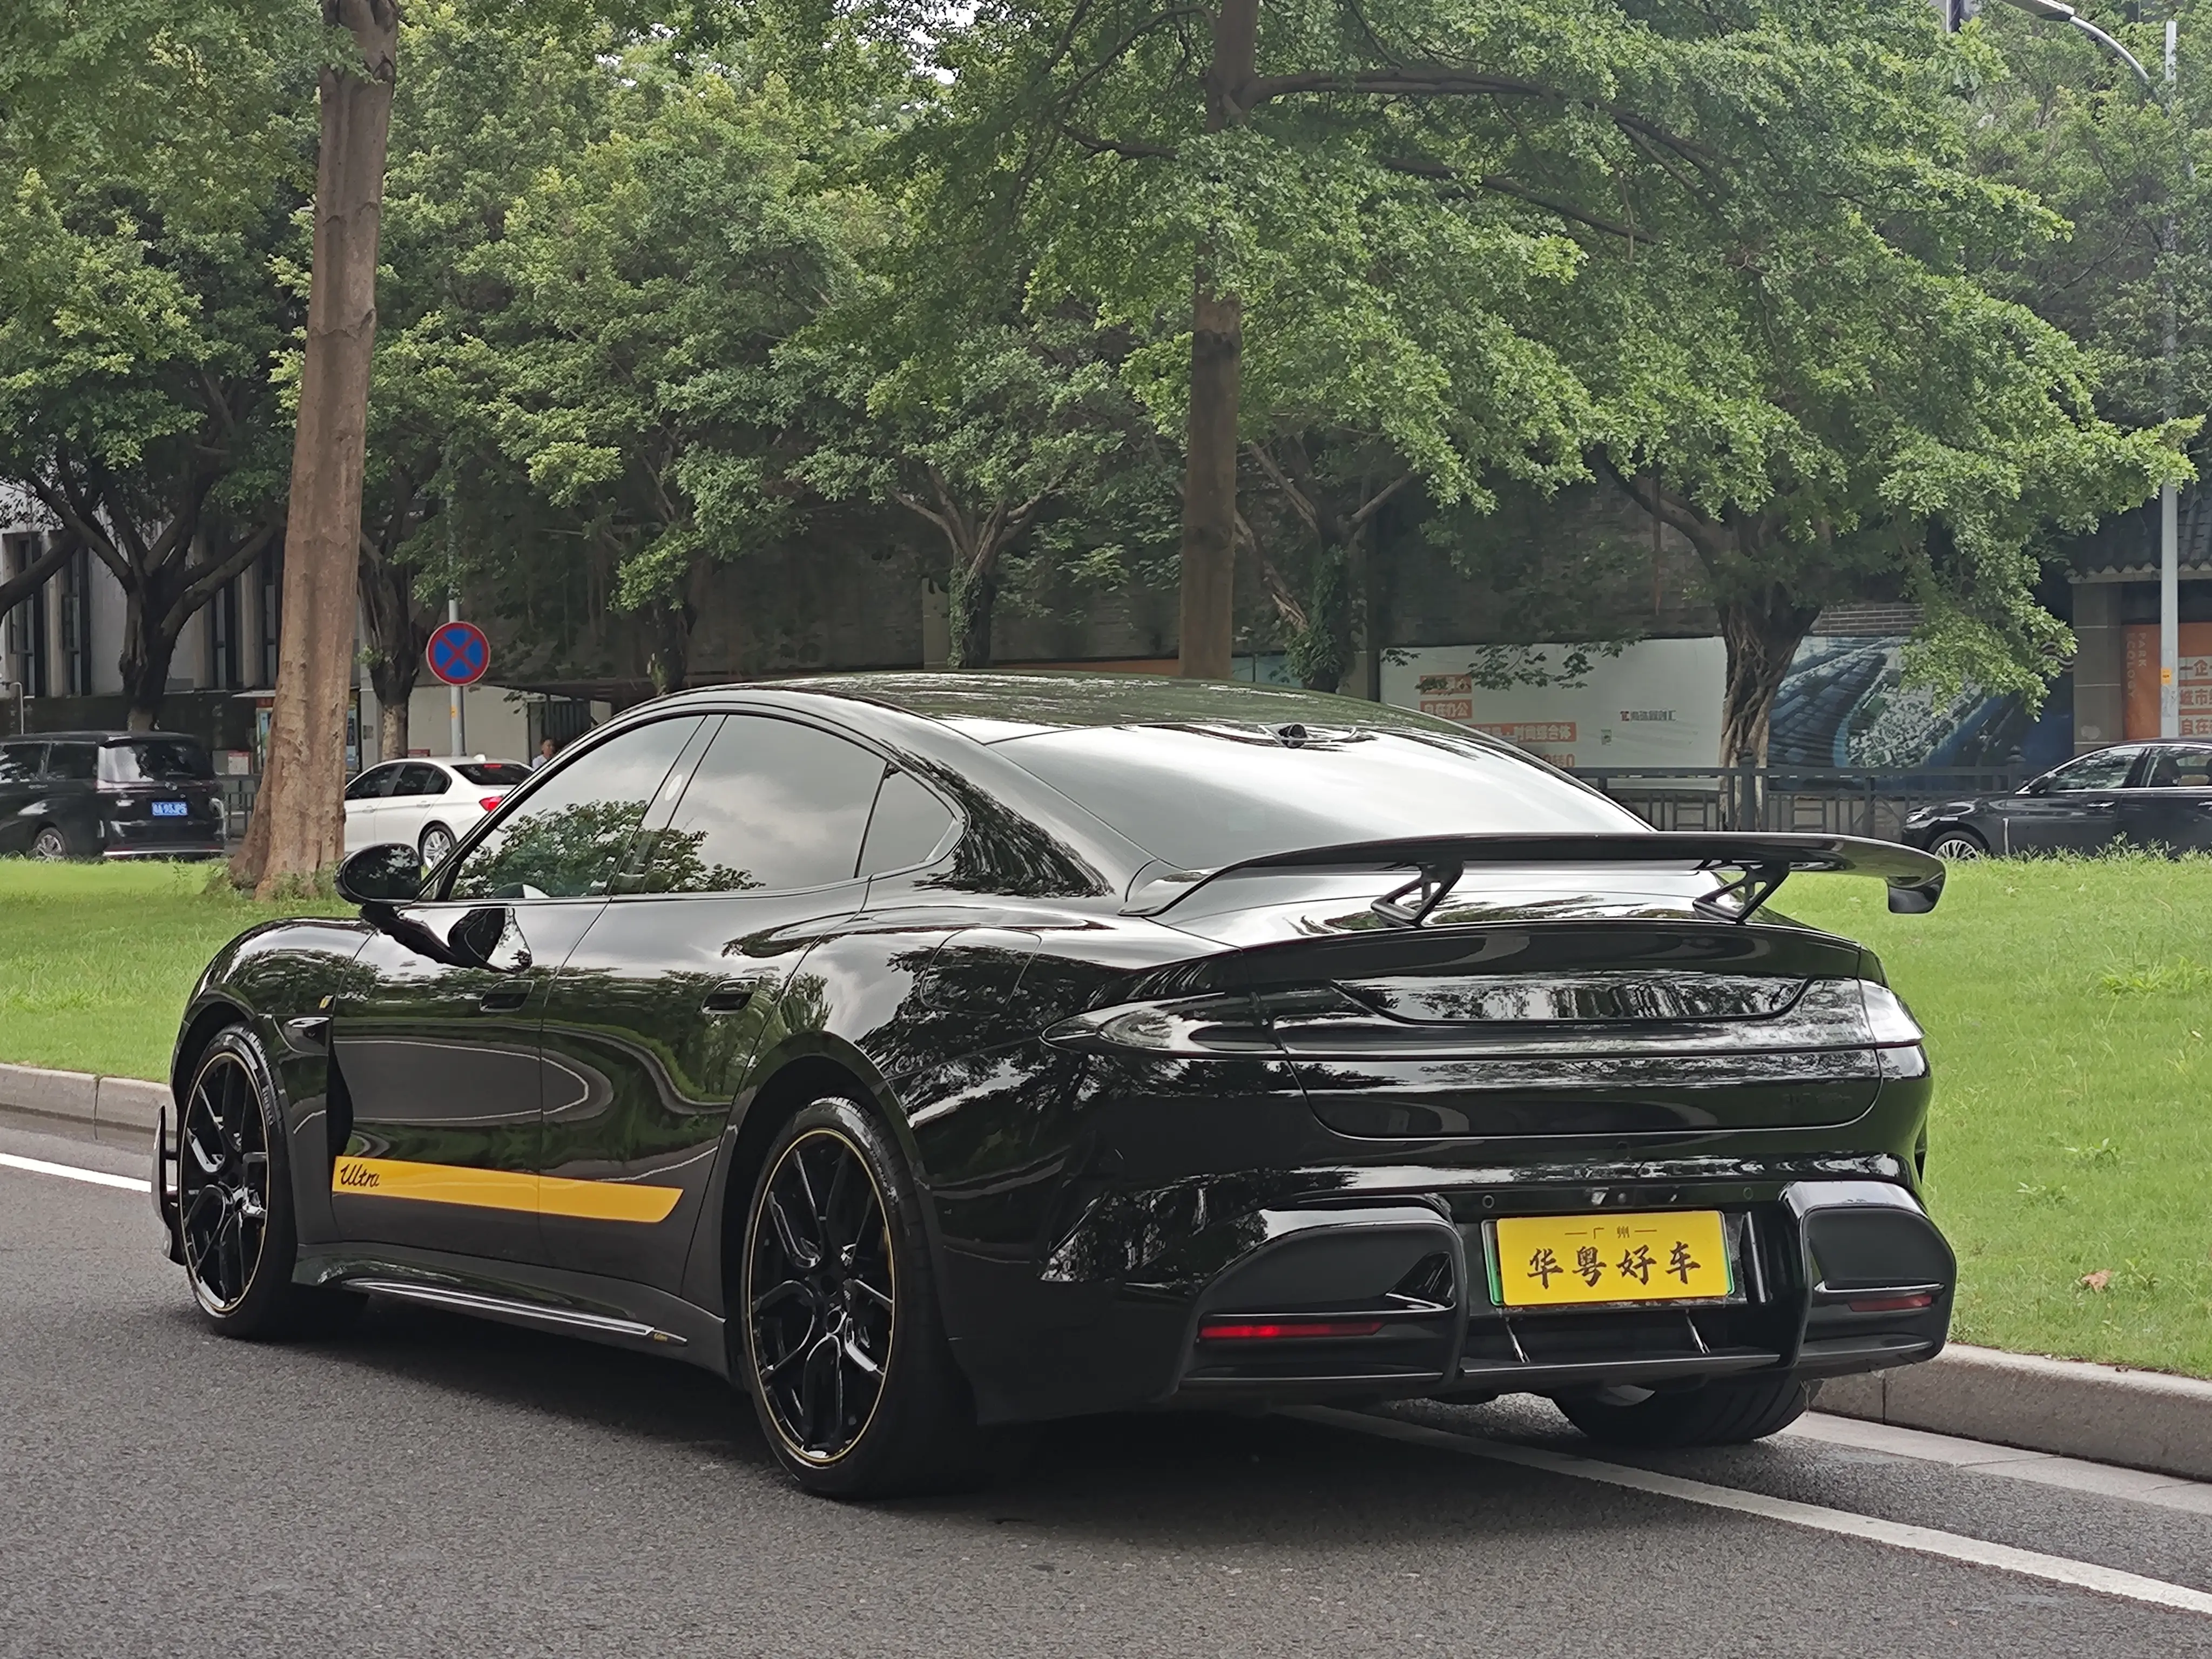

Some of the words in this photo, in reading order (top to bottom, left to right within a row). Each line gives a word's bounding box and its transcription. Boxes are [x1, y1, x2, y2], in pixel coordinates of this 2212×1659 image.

[2138, 632, 2147, 667] PARK
[2180, 659, 2212, 677] 一企
[2180, 688, 2212, 706] 城市
[2181, 718, 2212, 736] 自在
[340, 1163, 380, 1188] Ultra
[1593, 1225, 1630, 1239] 广州
[1527, 1240, 1702, 1290] 华粤好车
